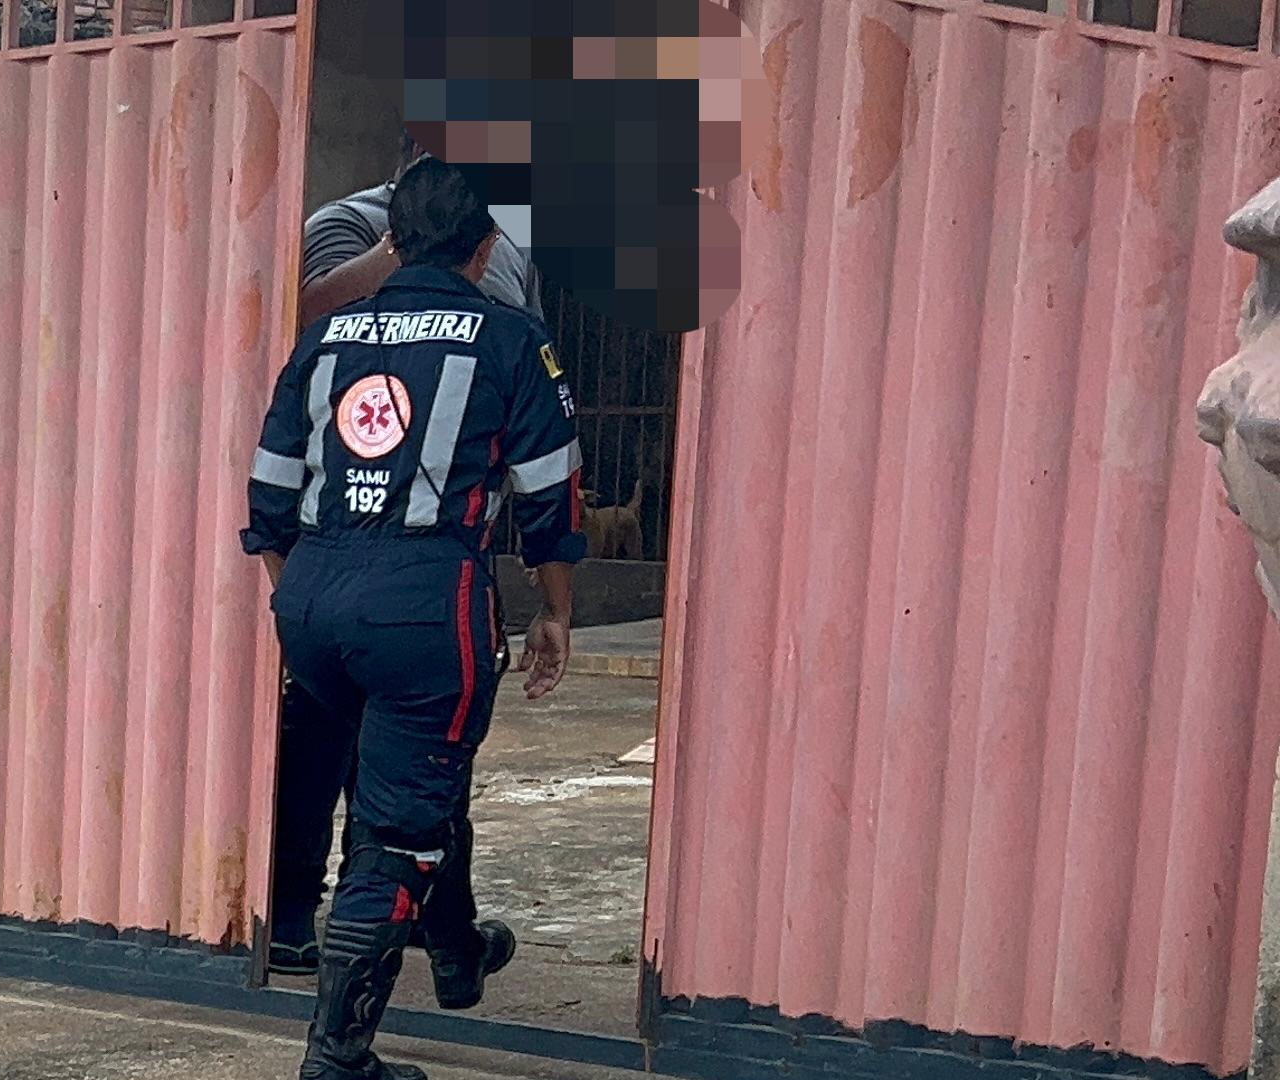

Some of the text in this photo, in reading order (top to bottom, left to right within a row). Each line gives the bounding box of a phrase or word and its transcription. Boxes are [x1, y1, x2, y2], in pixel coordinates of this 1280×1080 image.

[327, 314, 472, 342] ENFERMEIRA
[346, 469, 390, 486] SAMU
[344, 487, 387, 513] 192
